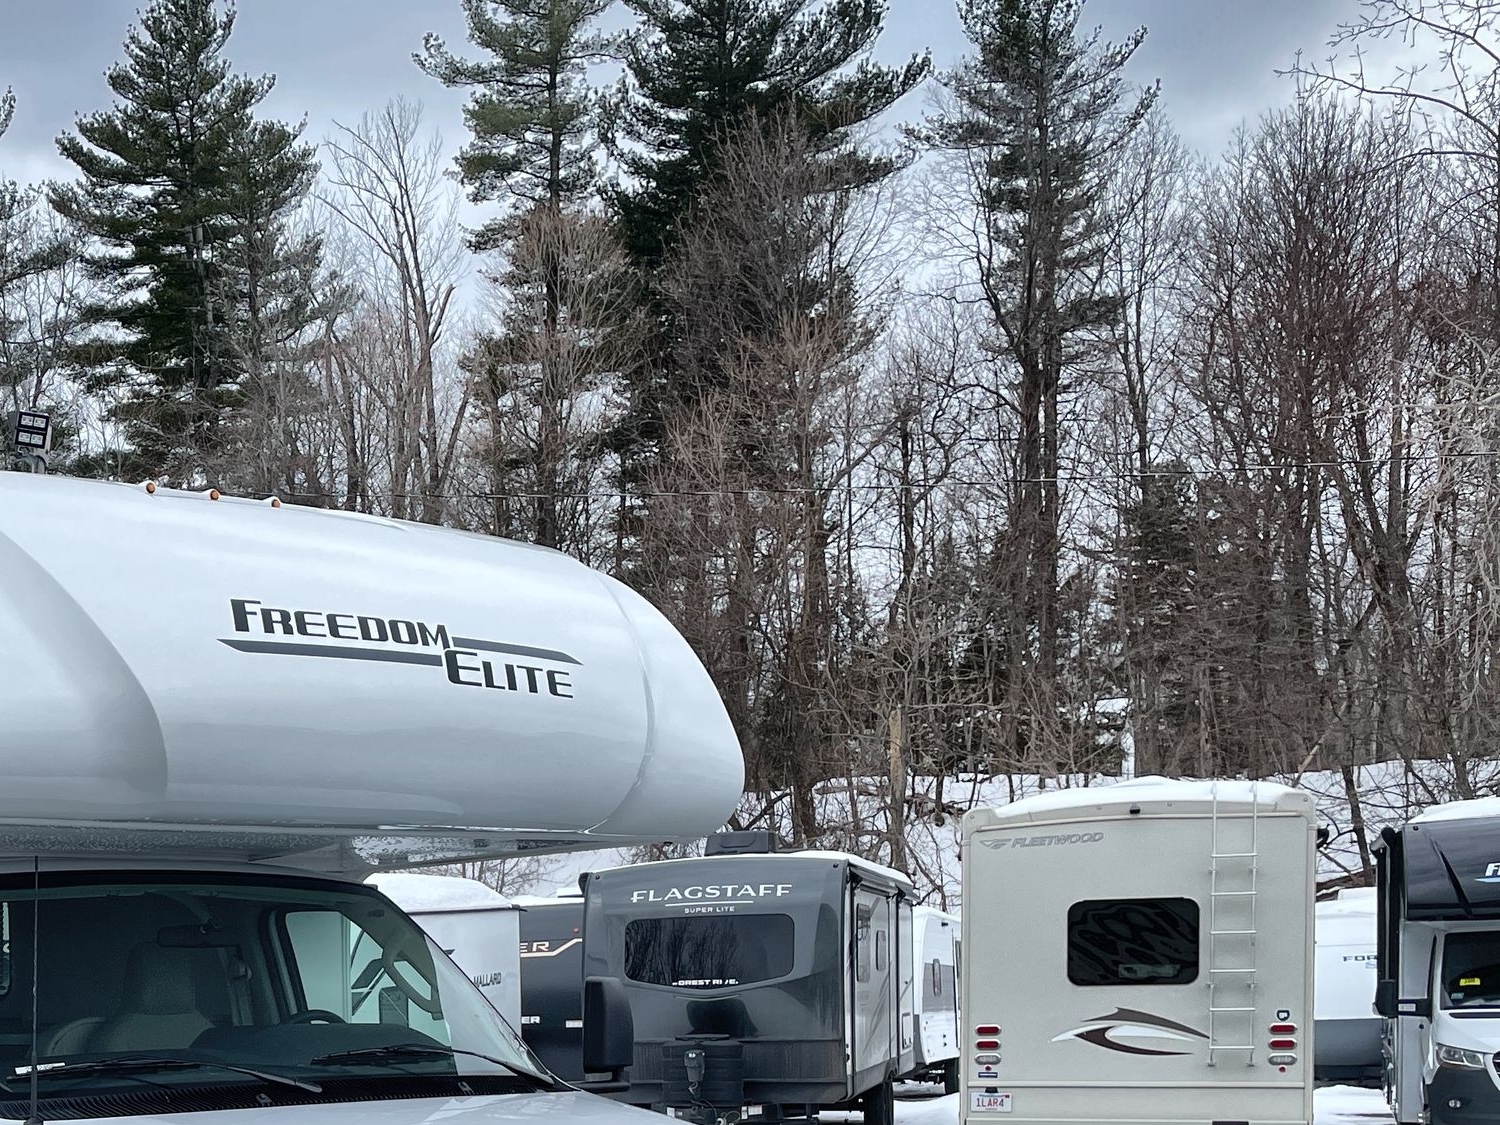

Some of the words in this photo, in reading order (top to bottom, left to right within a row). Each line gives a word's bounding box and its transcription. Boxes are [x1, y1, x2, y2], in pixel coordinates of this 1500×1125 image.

[230, 598, 450, 649] FREEDOM
[444, 649, 574, 699] ELITE
[1011, 832, 1104, 848] FLEETWOOD
[631, 884, 793, 903] FLAGSTAFF
[684, 906, 713, 914] SUPER
[976, 1098, 1004, 1107] 1LAR4
